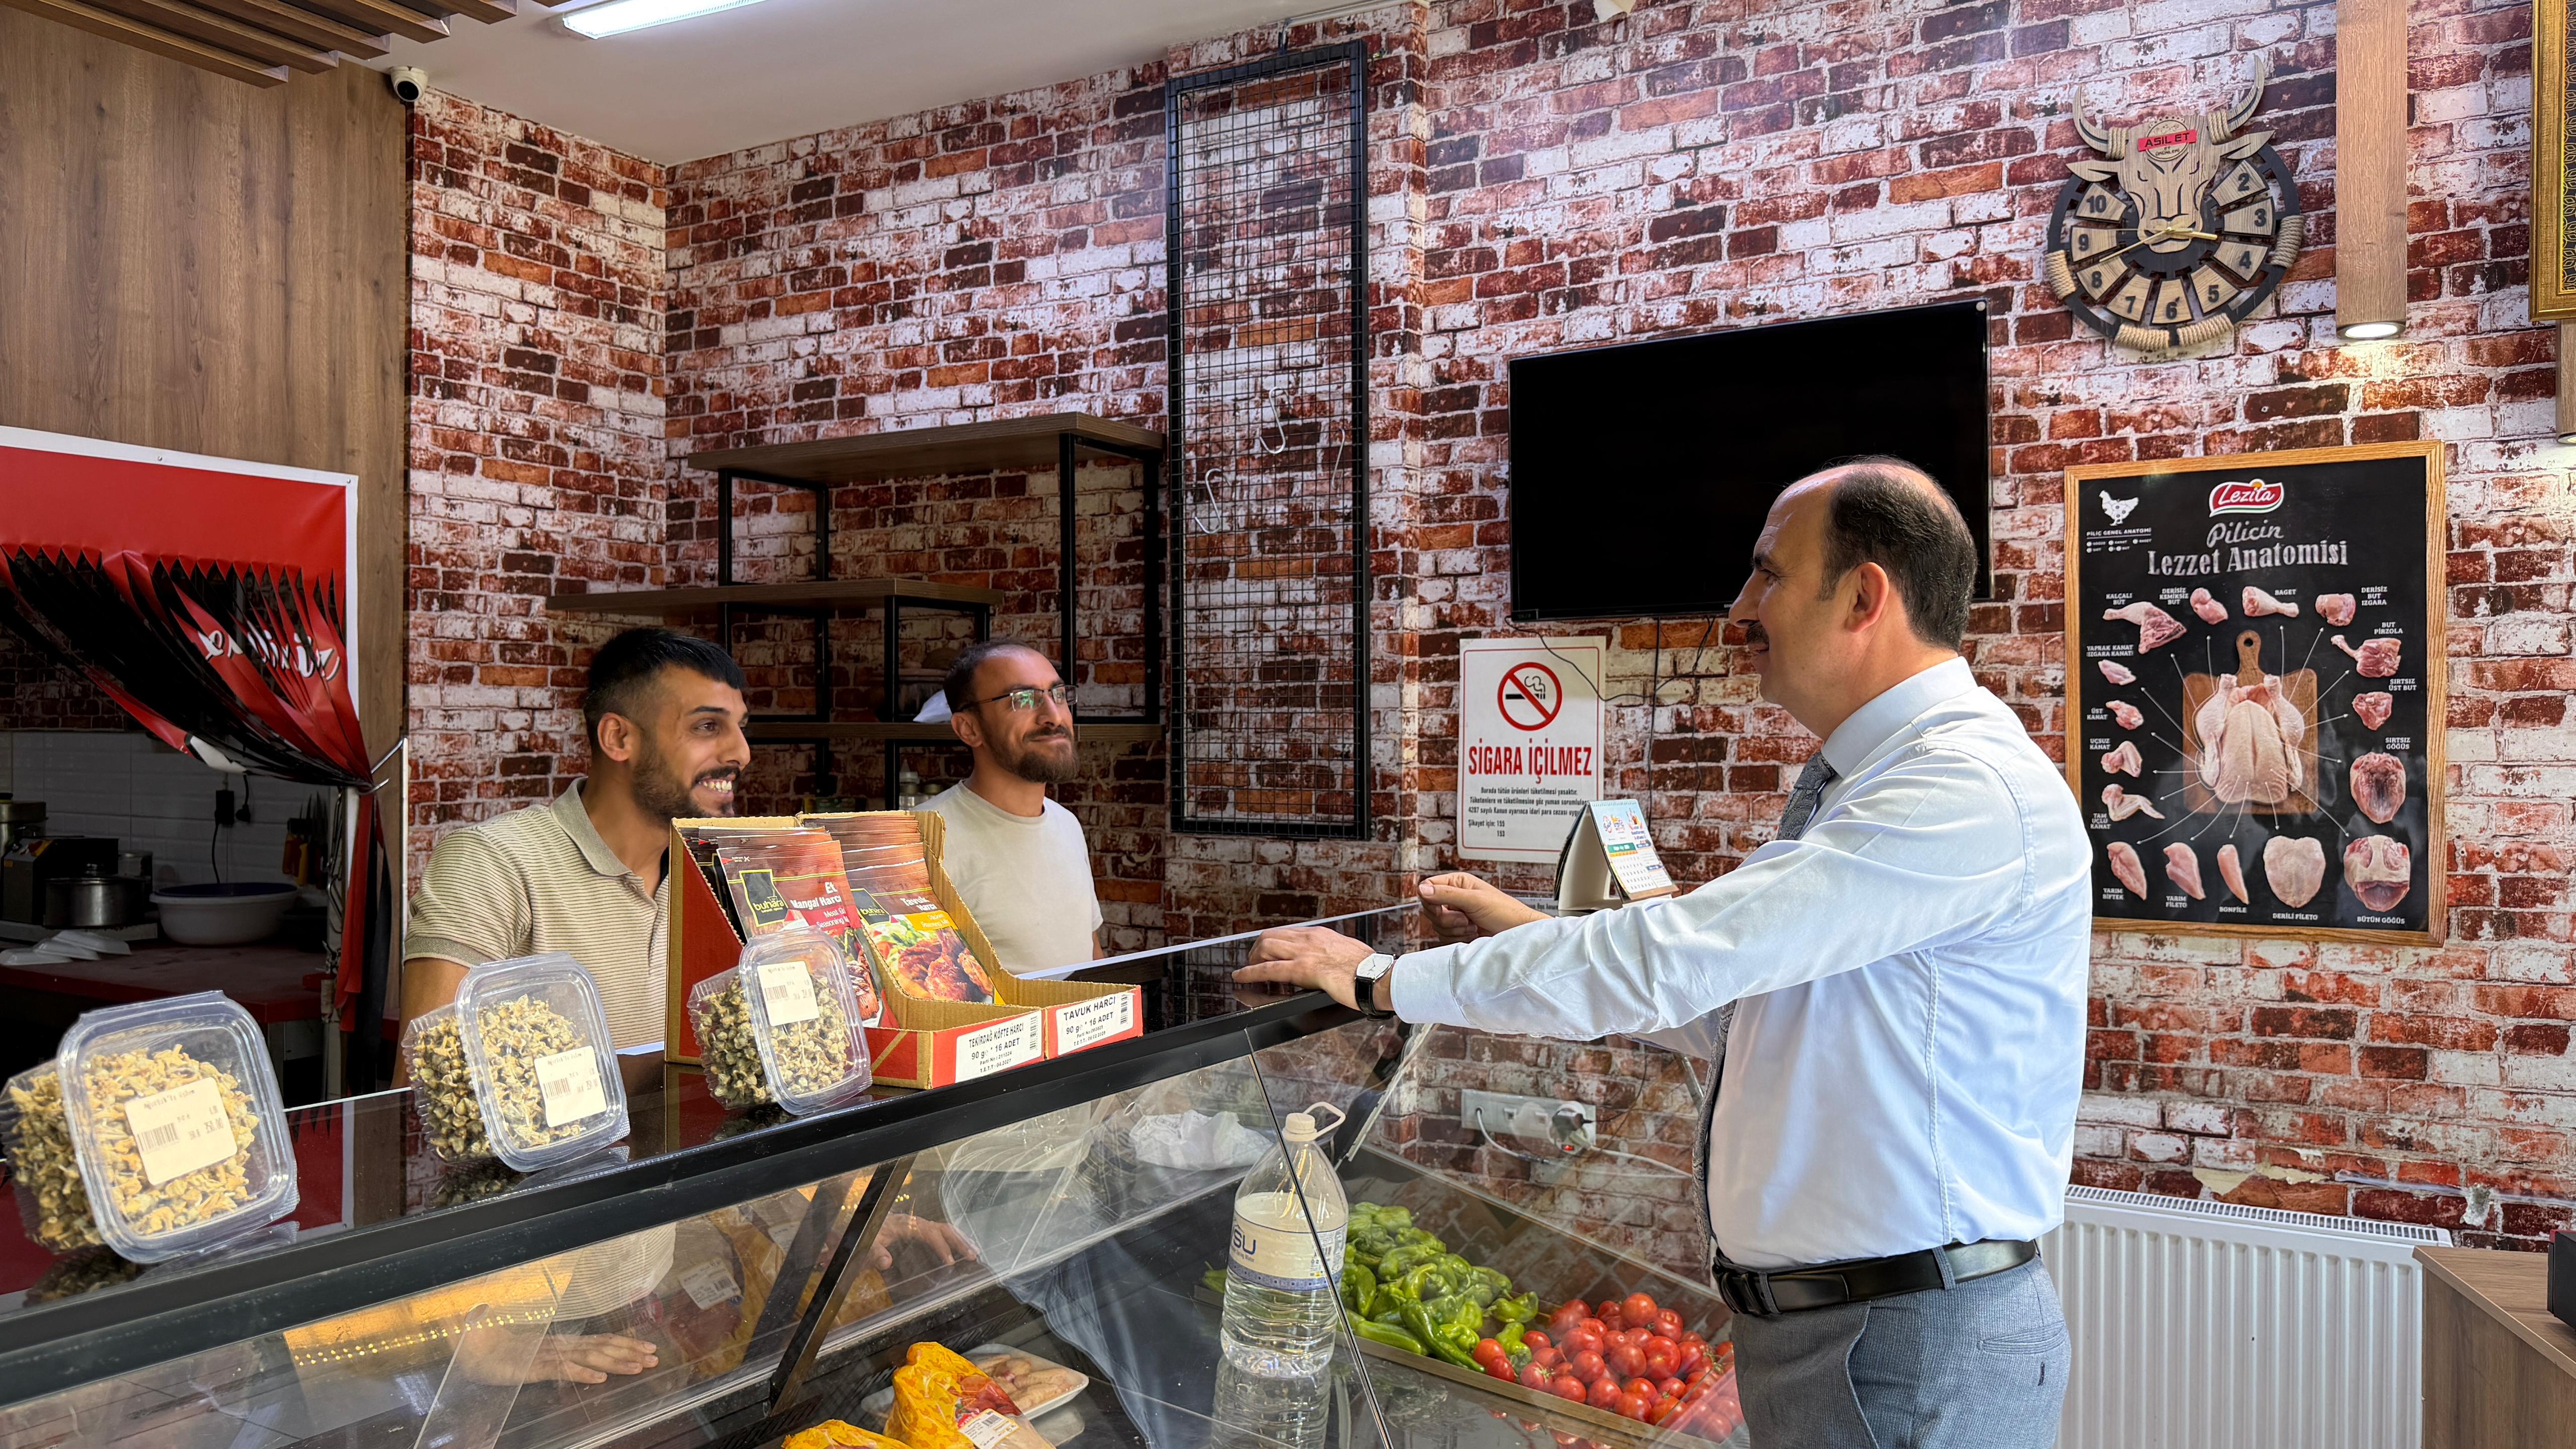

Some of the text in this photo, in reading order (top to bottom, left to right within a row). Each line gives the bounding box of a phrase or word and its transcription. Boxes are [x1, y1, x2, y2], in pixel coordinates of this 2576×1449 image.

[2175, 133, 2190, 142] ET
[2237, 173, 2250, 191] 2
[2086, 195, 2107, 214] 10
[2255, 208, 2267, 227] 3
[2078, 234, 2089, 251] 9
[2239, 251, 2251, 269] 4
[2091, 271, 2102, 289] 8
[2208, 284, 2219, 303] 5
[2126, 295, 2137, 313] 7
[2166, 297, 2179, 320] 6
[2218, 485, 2275, 505] Lezita
[2206, 519, 2284, 548] Pilicin
[2147, 540, 2349, 576] Lezzet Anatomisi
[1468, 738, 1591, 784] SİGARA İÇİLMEZ
[1468, 819, 1485, 828] Şikayet
[1486, 820, 1495, 828] için:
[825, 882, 838, 894] Et
[753, 898, 784, 911] buhara
[790, 898, 820, 910] Mangal
[900, 896, 930, 906] Tavuk
[824, 909, 838, 918] Meat
[860, 907, 885, 915] buhara
[816, 917, 845, 929] Seasoning
[1064, 996, 1115, 1021] TAVUK HARCI
[1066, 1026, 1074, 1034] 90
[1089, 1018, 1096, 1026] 16
[1098, 1012, 1113, 1023] ADET
[969, 1022, 1024, 1048] TEKİRDAĞ KÖFTE HARCI
[972, 1051, 979, 1060] 90
[995, 1043, 1002, 1052] 16
[1004, 1038, 1020, 1049] ADET
[1233, 1229, 1256, 1255] SU
